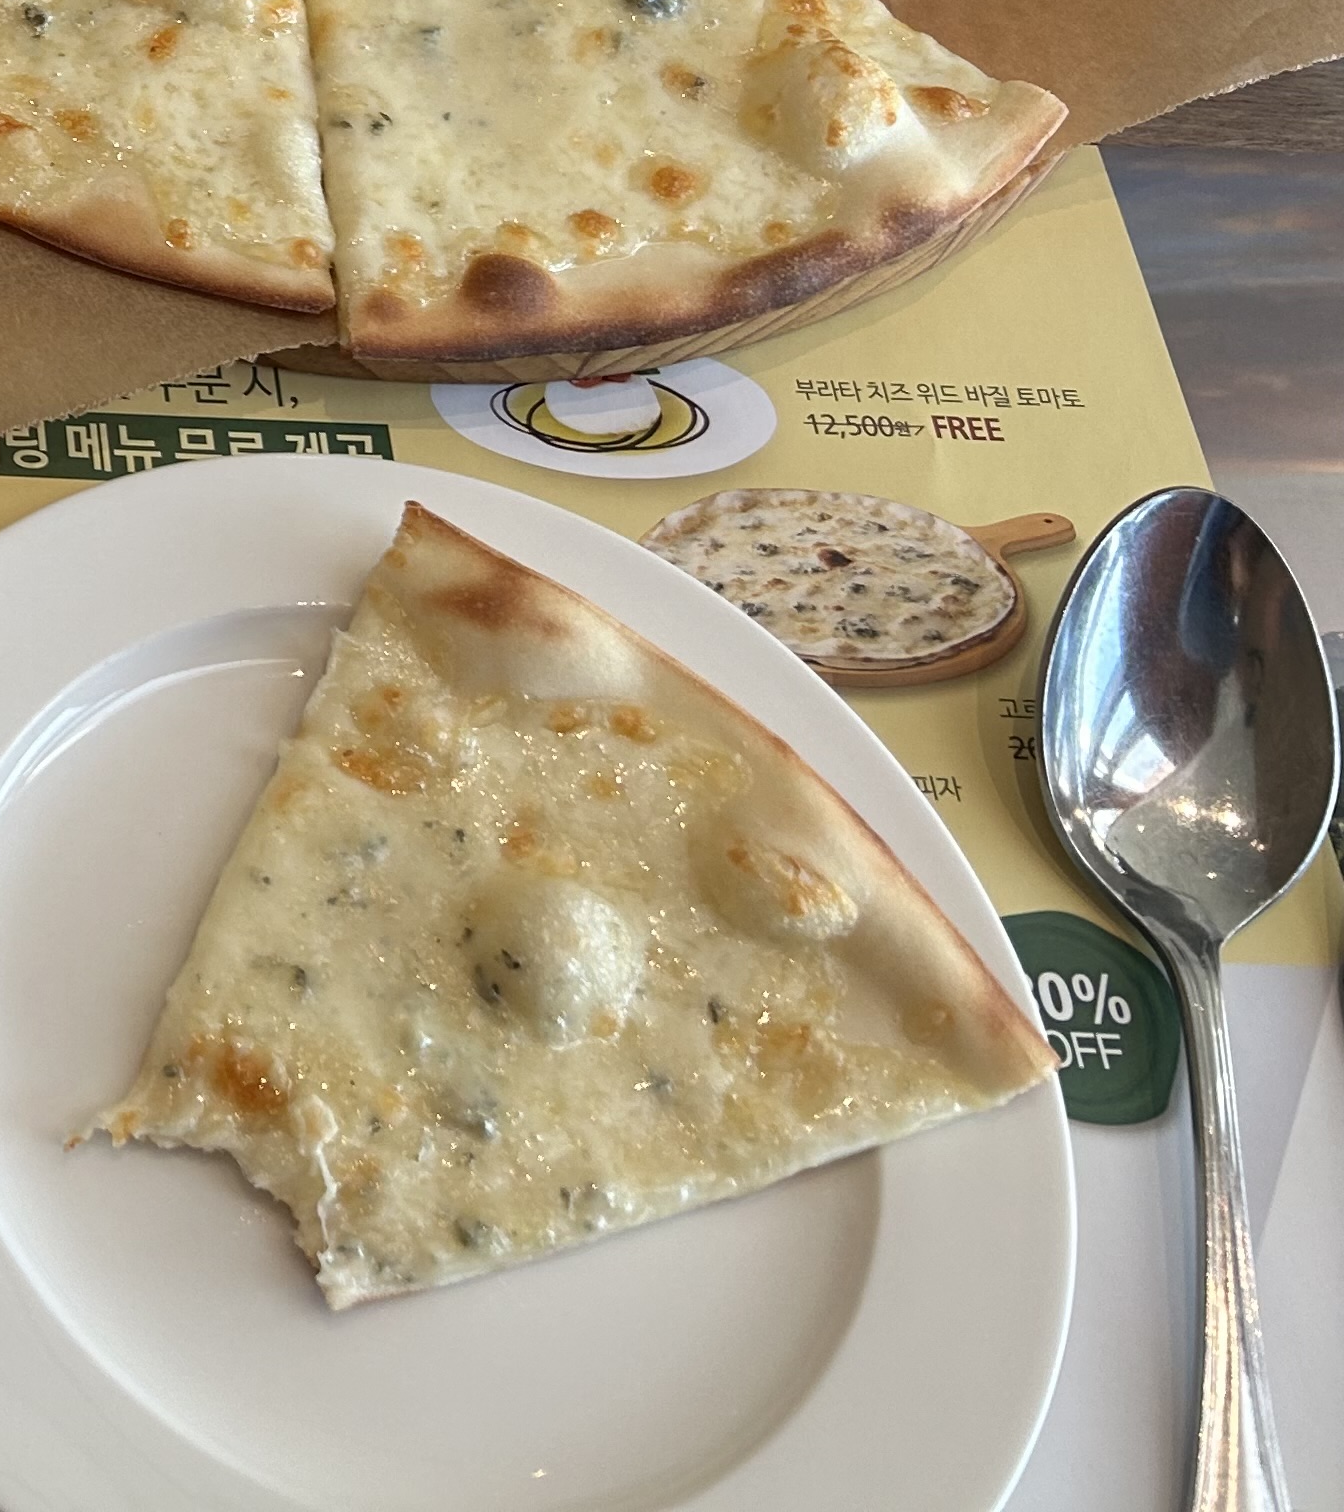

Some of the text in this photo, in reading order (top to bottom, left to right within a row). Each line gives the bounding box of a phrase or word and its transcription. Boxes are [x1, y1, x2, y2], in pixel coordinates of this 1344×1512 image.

[795, 379, 1085, 408] 부라타 치즈 위드 바질 토마토
[66, 423, 163, 473] 메뉴
[931, 415, 1005, 442] FREE
[1030, 970, 1133, 1026] 0%
